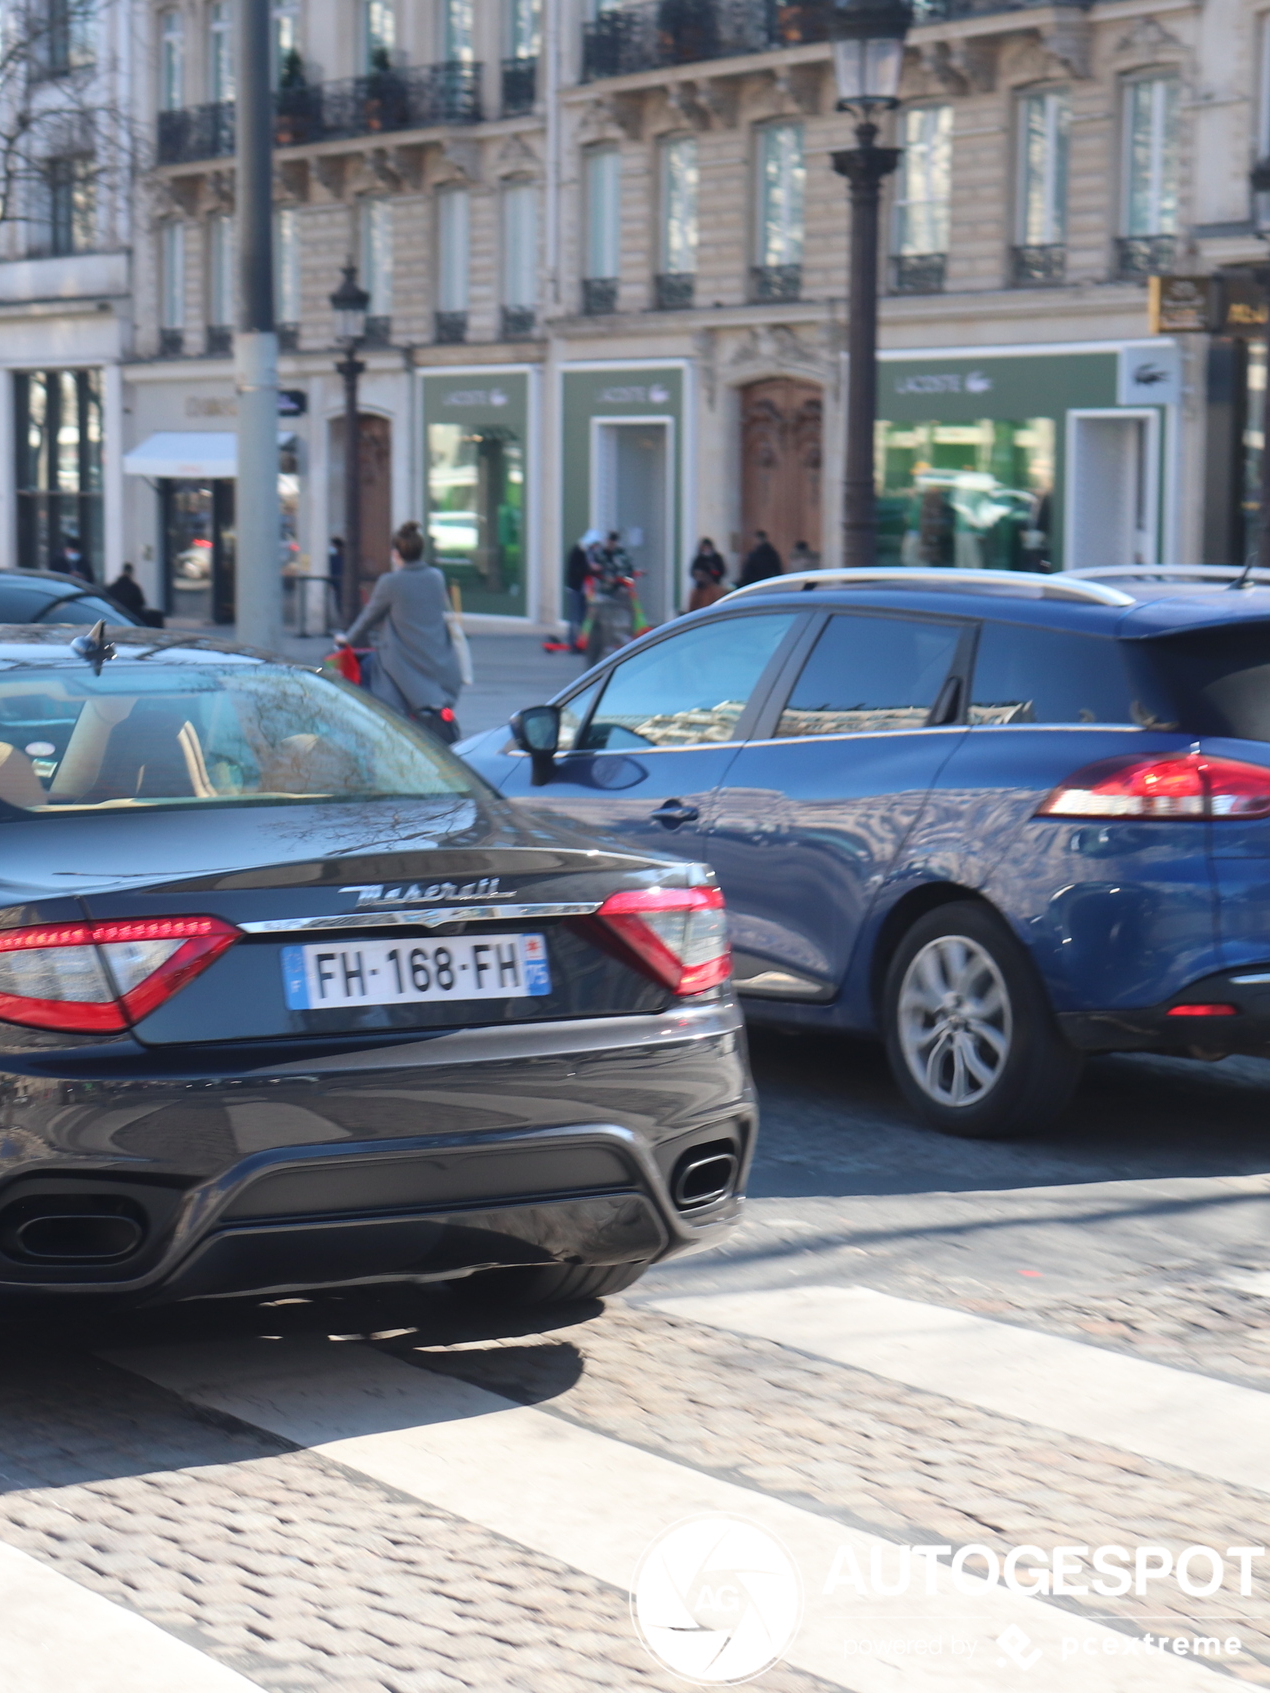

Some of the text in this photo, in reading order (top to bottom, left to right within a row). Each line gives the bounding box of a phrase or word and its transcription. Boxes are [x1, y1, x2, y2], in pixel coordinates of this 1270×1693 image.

[894, 374, 961, 394] LACOSTE
[338, 877, 517, 908] Maserati
[314, 943, 522, 999] FH-168-FH
[526, 965, 549, 986] 75
[290, 980, 302, 994] F
